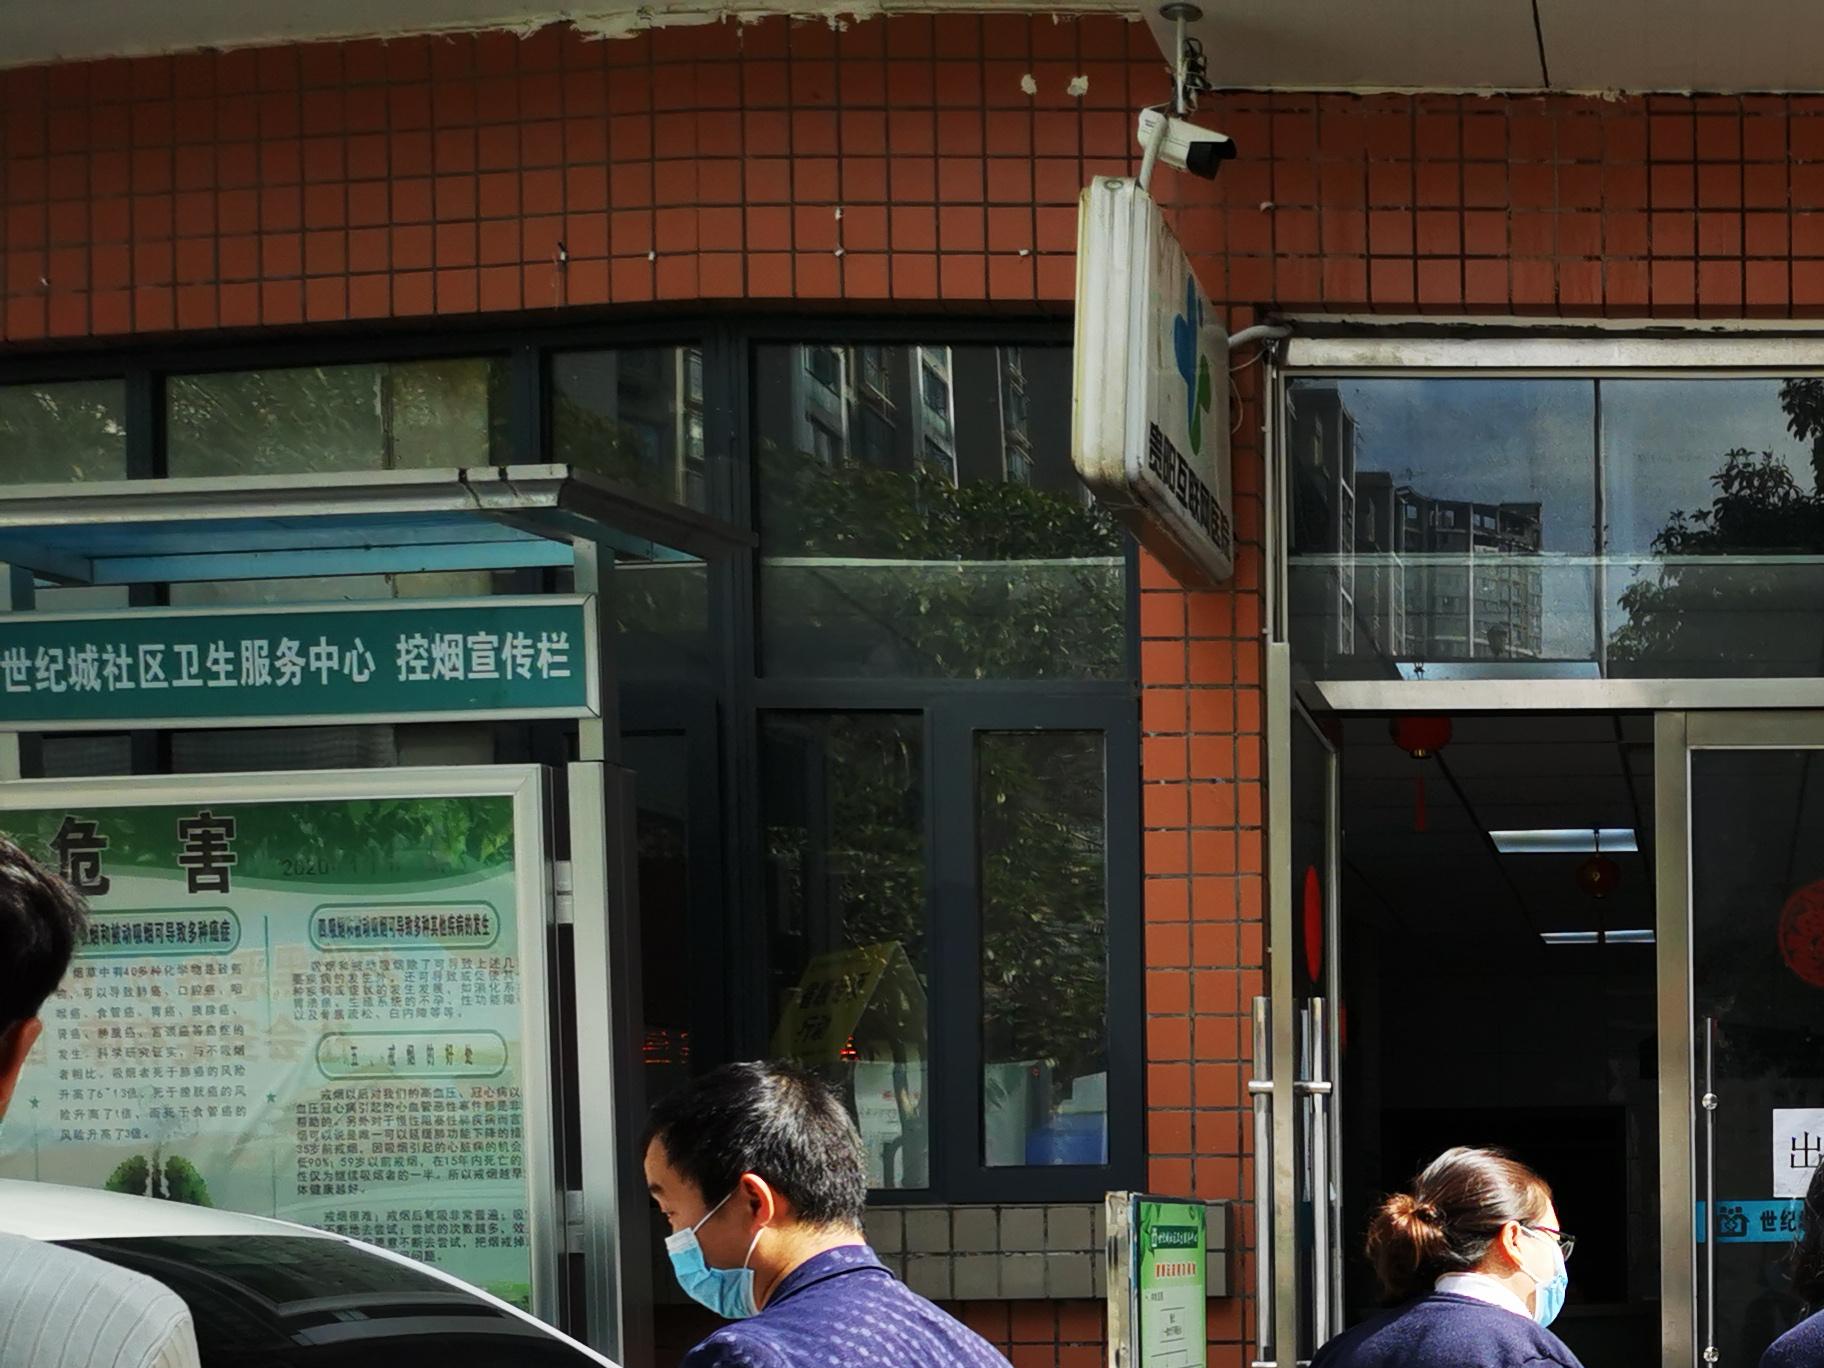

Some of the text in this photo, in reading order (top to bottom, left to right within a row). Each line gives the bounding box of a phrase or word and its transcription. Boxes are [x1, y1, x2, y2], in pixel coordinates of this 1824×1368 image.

[1, 630, 571, 694] 世纪城社区卫生服务中心 控烟宣传栏
